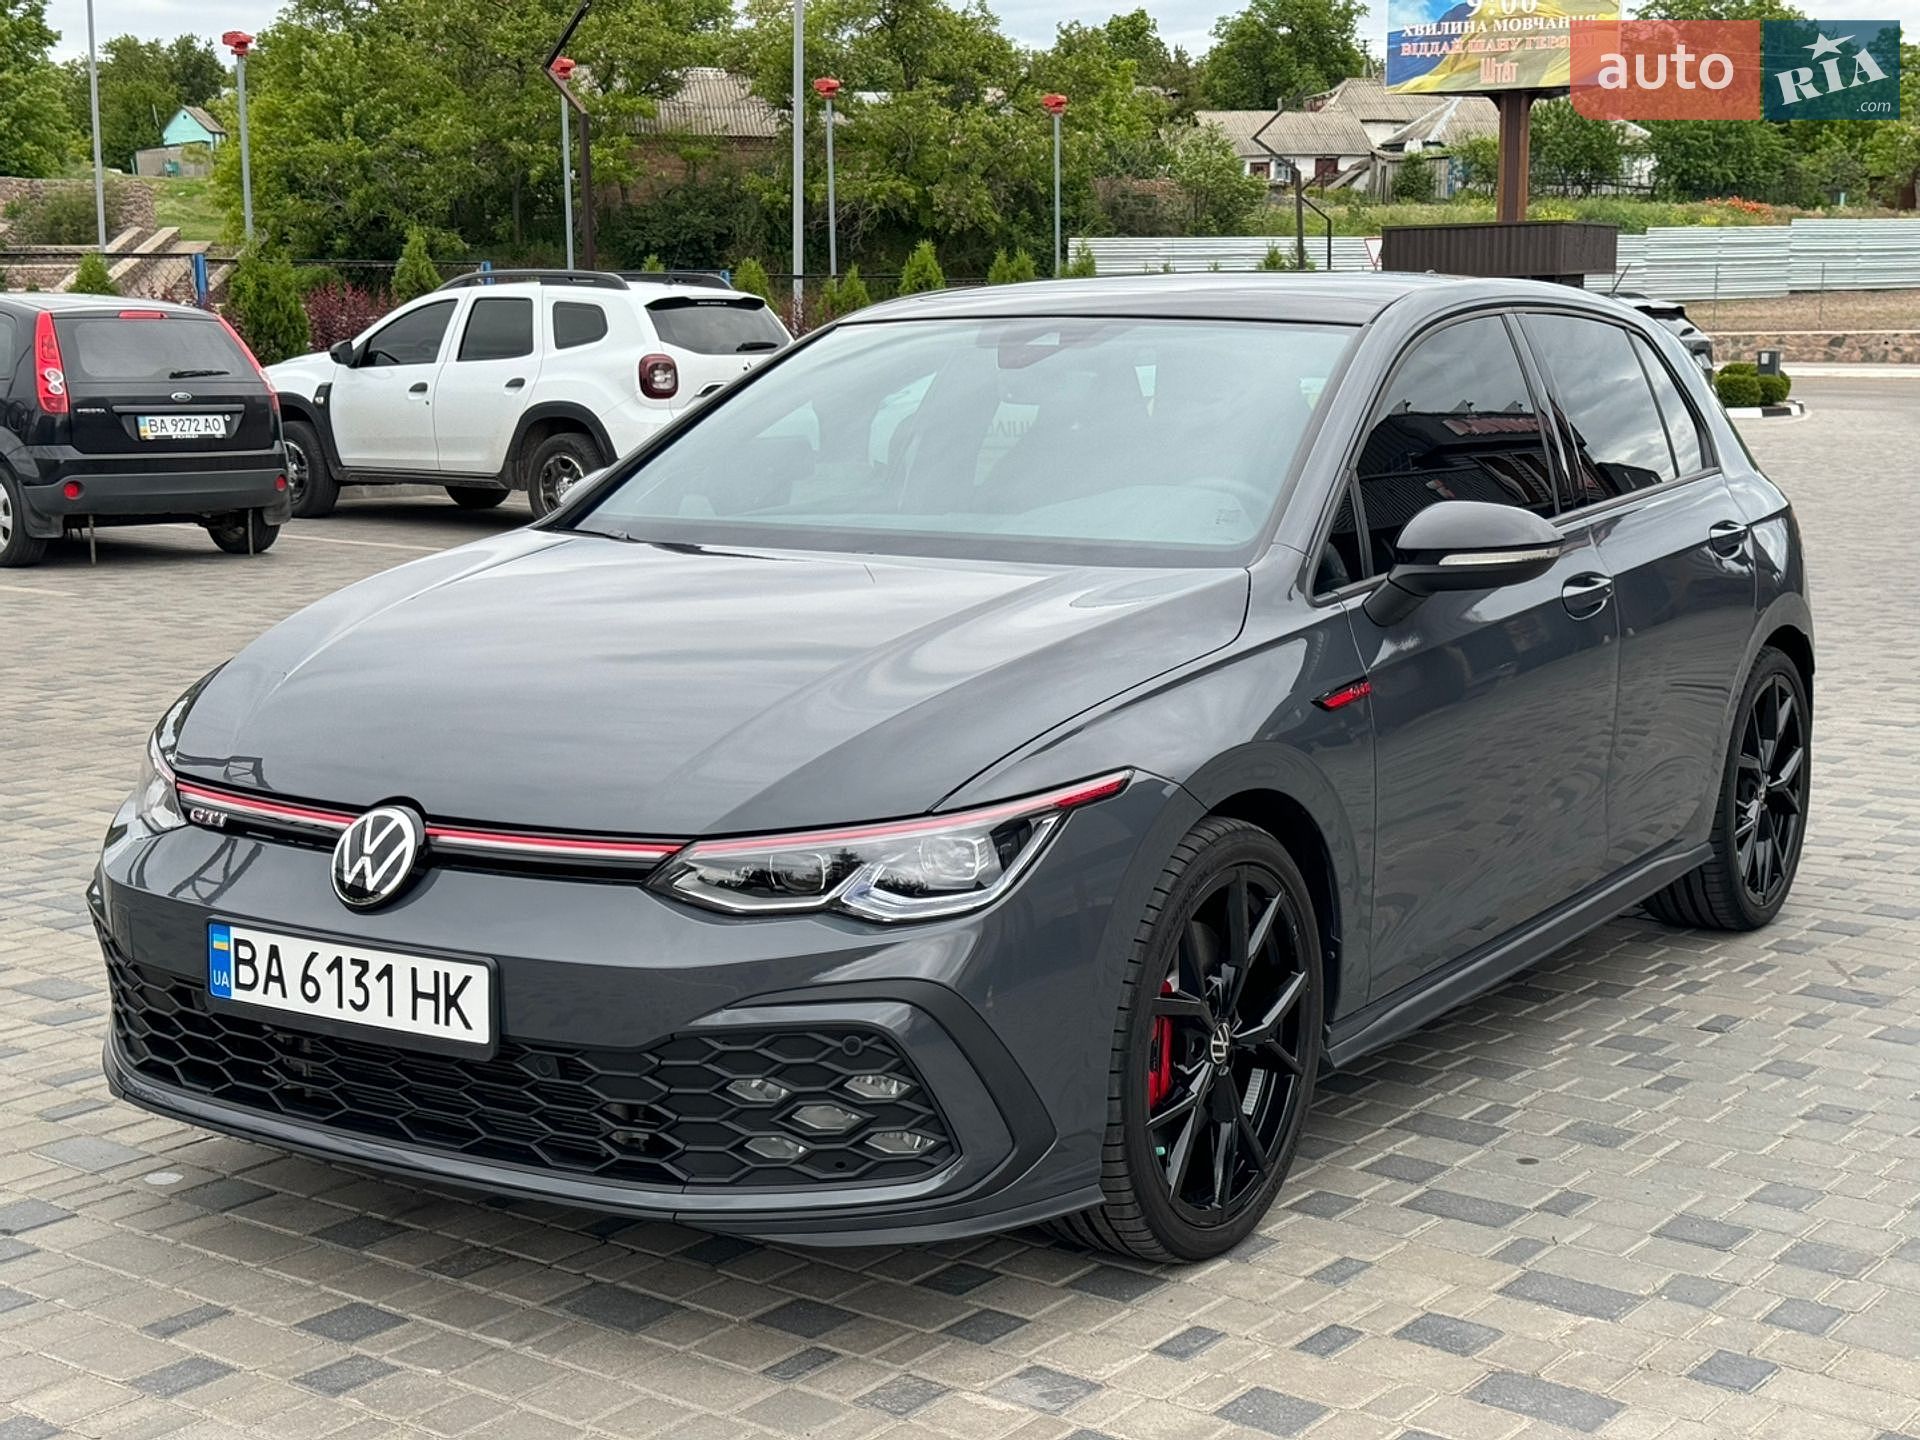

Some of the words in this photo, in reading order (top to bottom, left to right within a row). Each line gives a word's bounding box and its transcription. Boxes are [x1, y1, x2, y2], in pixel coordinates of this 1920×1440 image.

[1402, 20, 1487, 37] ХВИЛИНА
[1400, 37, 1465, 58] ВІДДАЙ
[148, 418, 169, 433] BA
[170, 417, 202, 433] 9272
[204, 417, 222, 432] AO
[190, 808, 228, 827] GTI
[213, 970, 230, 988] UA
[233, 938, 288, 999] BA
[299, 951, 394, 1018] 6131
[410, 966, 473, 1031] HK
